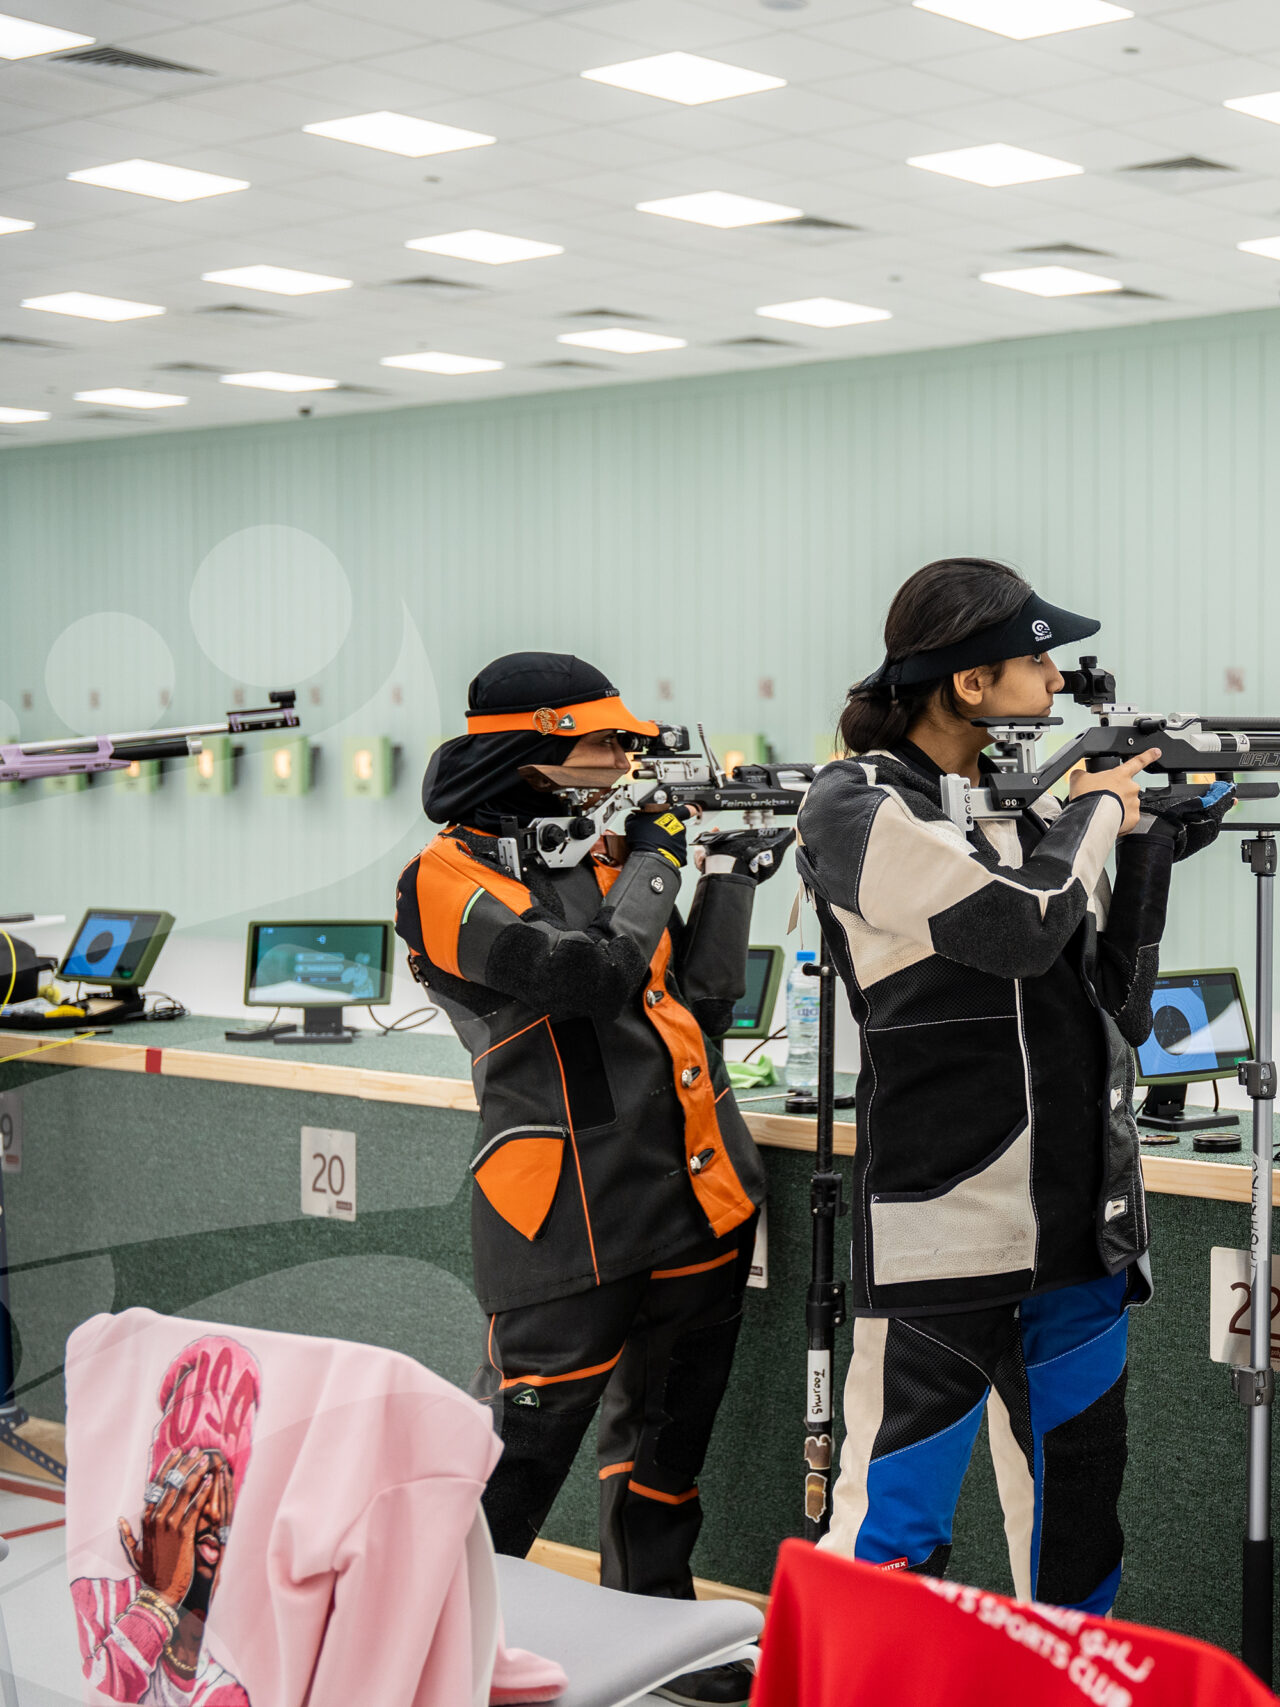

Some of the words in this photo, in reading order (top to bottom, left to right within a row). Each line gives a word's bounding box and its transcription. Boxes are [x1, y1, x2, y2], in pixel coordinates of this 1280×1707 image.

[311, 1152, 345, 1196] 20
[168, 1346, 258, 1449] USA
[977, 1597, 1073, 1670] SPORTS
[1067, 1654, 1133, 1707] CLUB
